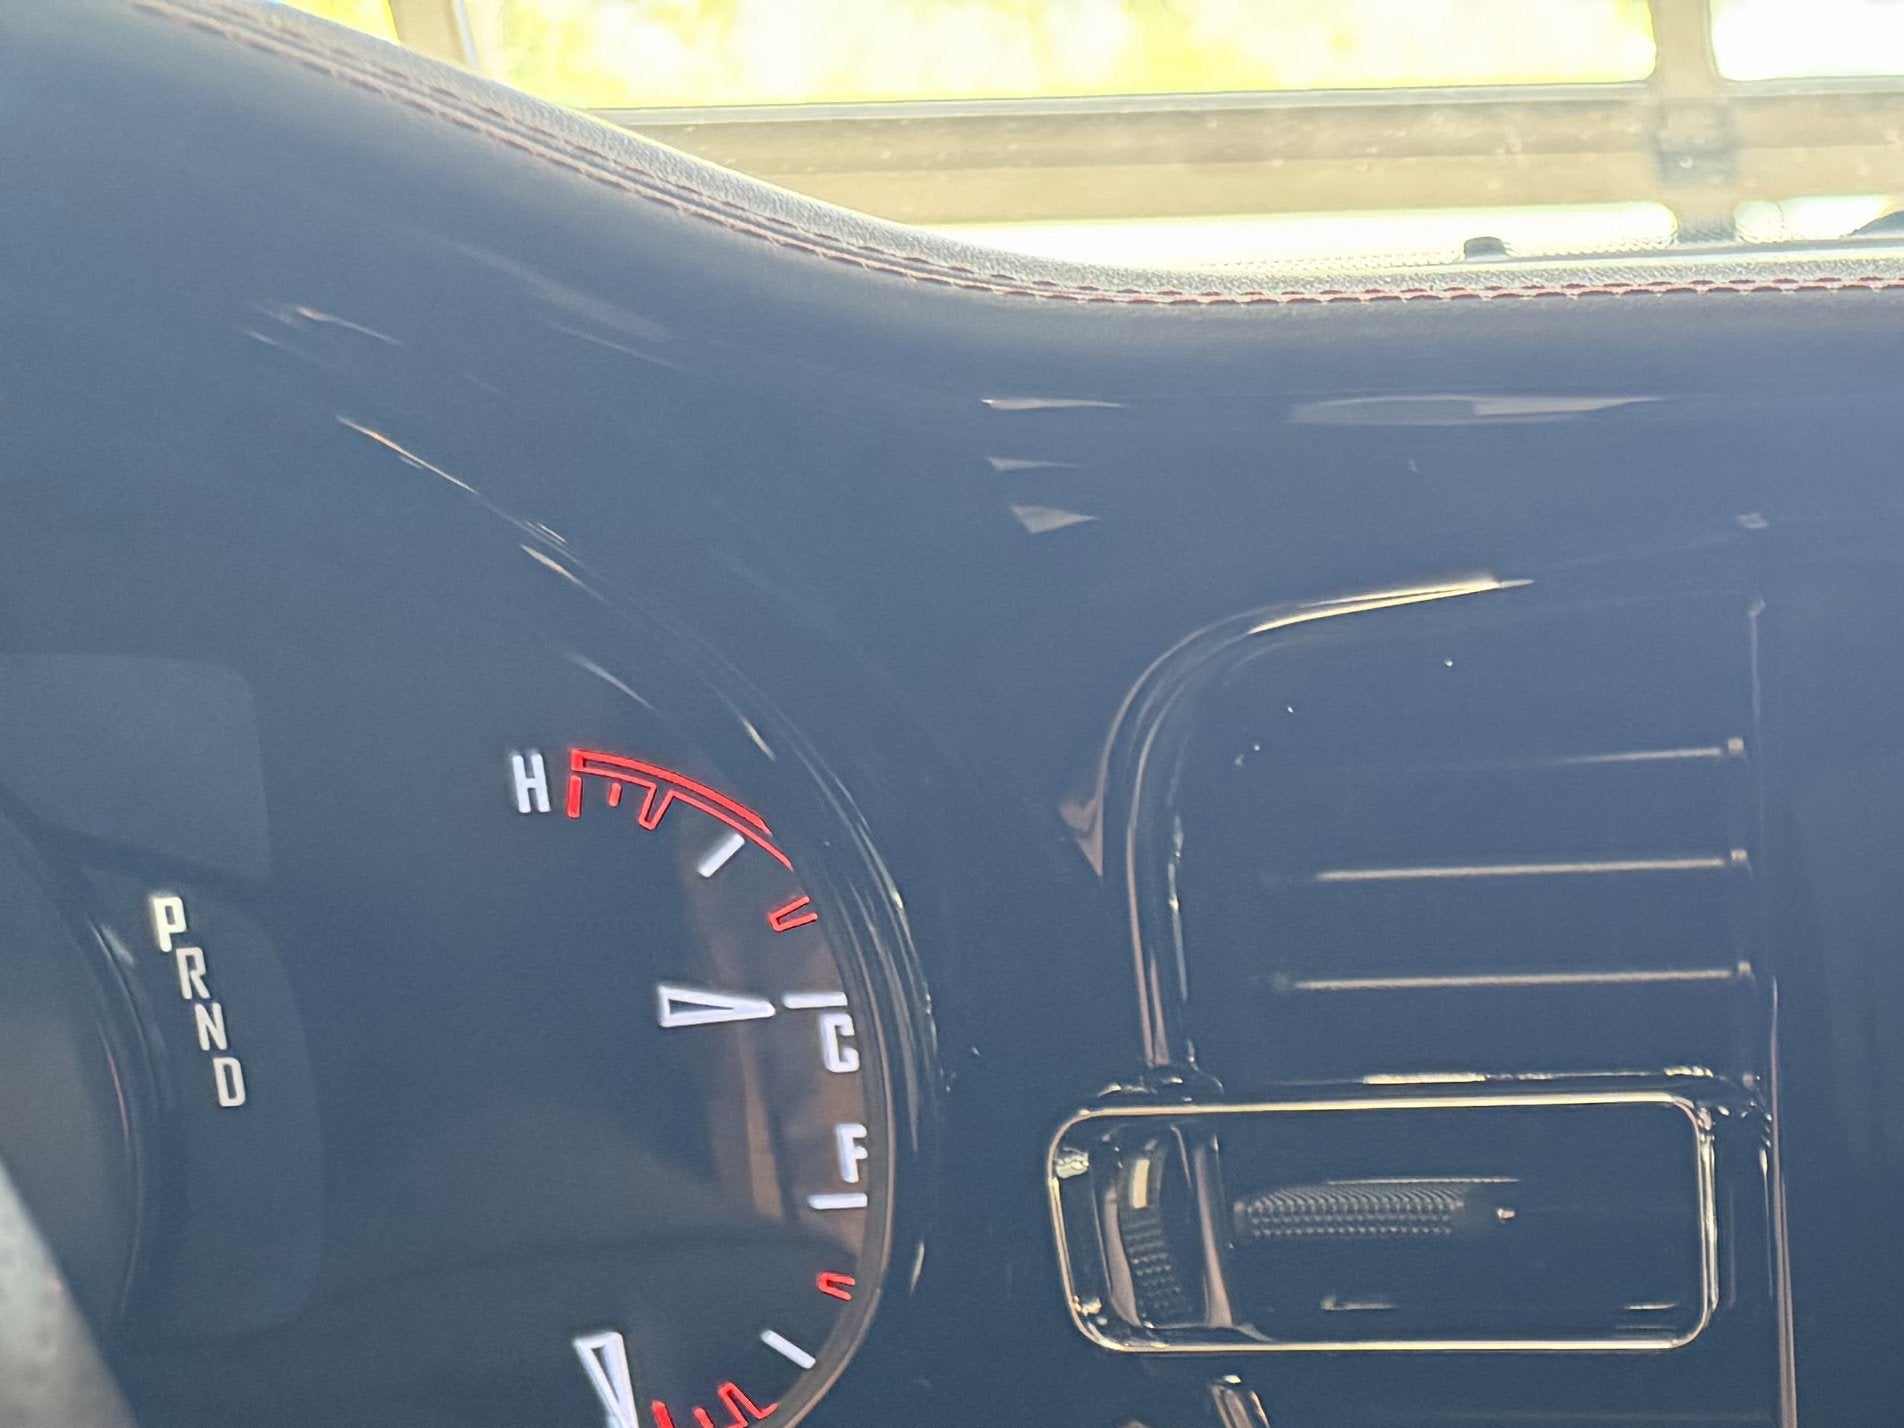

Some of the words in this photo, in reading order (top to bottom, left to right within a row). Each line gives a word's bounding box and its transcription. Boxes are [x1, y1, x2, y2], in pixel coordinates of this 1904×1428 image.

[511, 754, 550, 812] H
[823, 1016, 859, 1072] C
[836, 1125, 867, 1182] F
